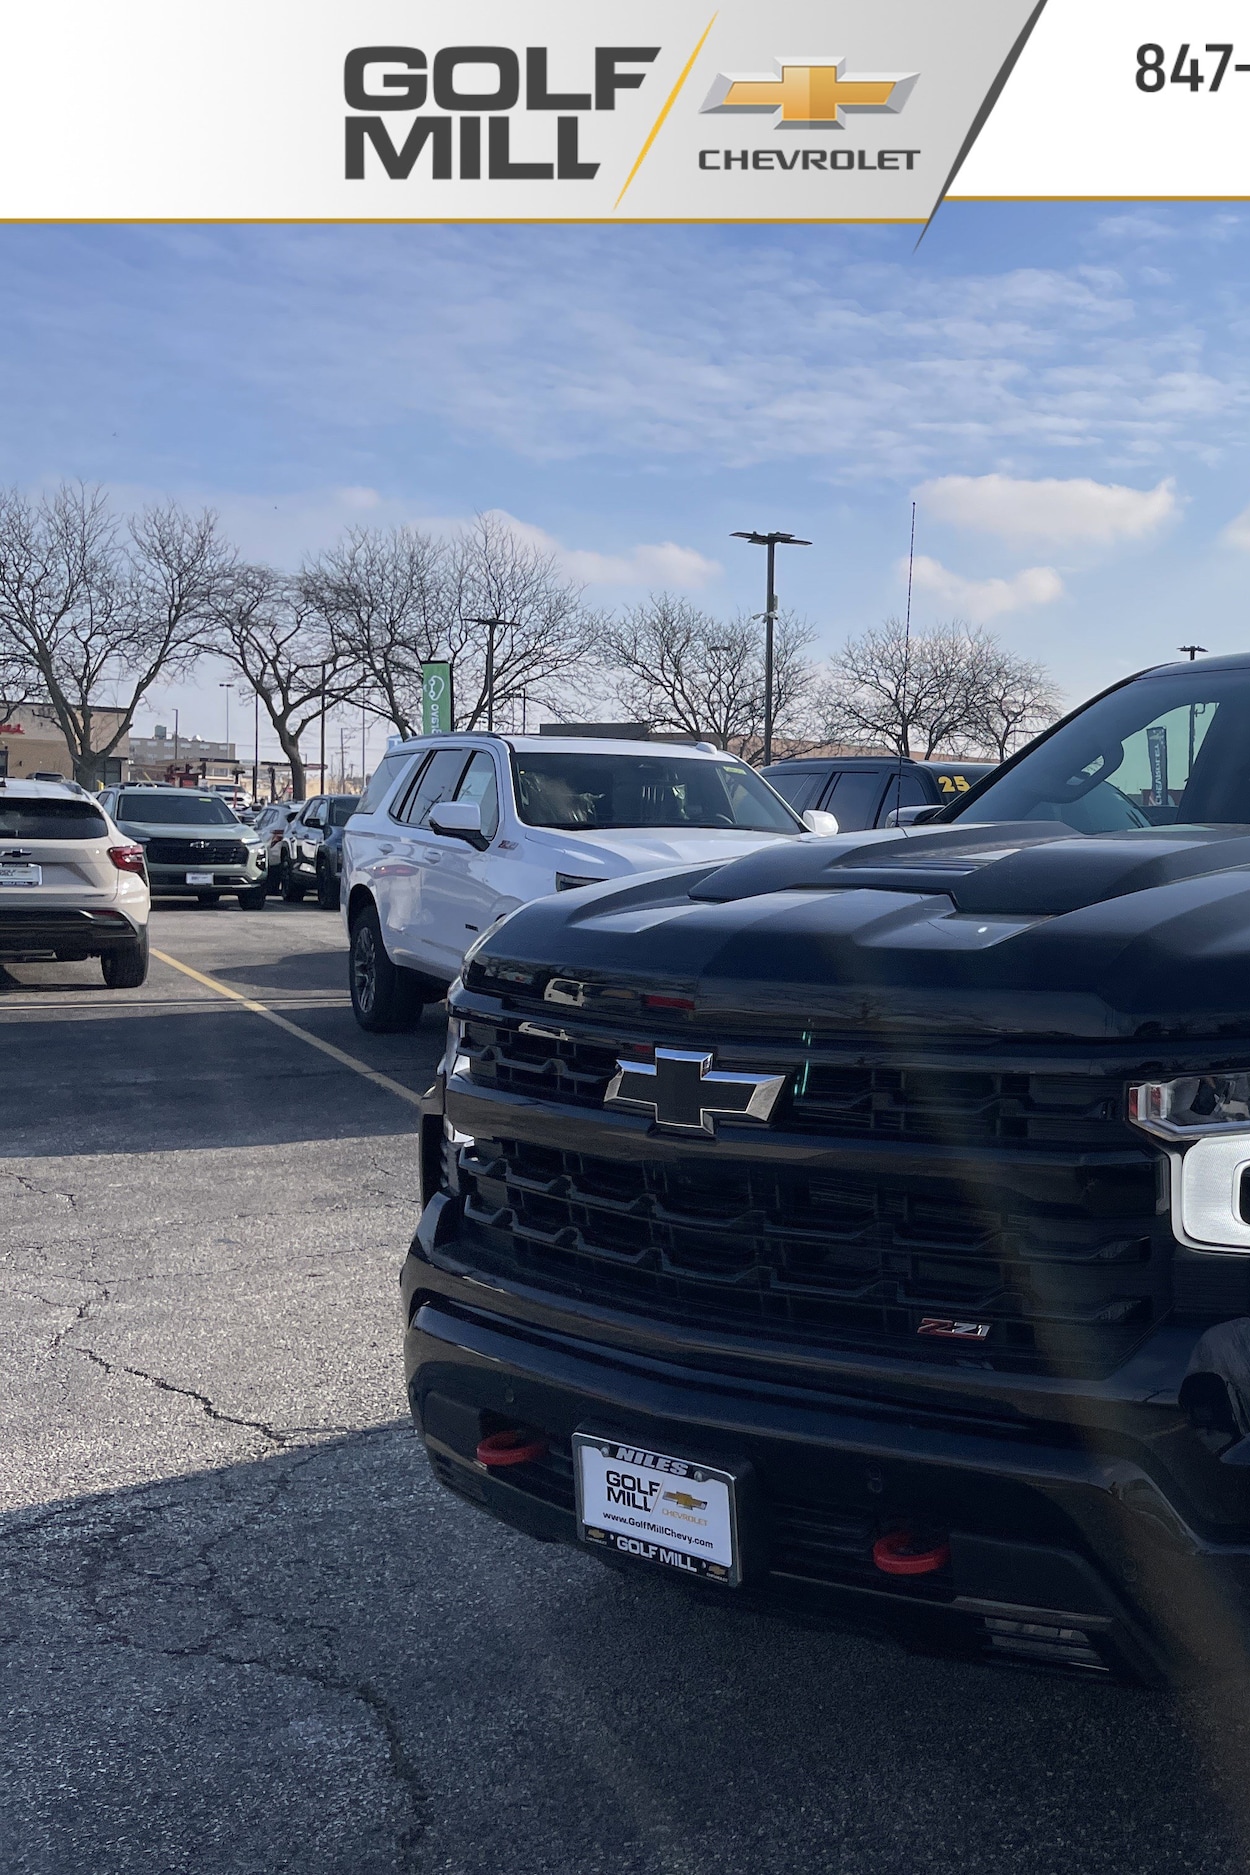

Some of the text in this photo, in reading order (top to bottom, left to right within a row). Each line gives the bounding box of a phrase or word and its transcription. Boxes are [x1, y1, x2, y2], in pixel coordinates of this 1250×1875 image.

[937, 775, 971, 793] 25
[615, 1446, 690, 1477] NILES
[606, 1470, 661, 1497] GOLF
[606, 1486, 652, 1513] MILL
[602, 1511, 715, 1550] www.GolfMillChevy.com
[661, 1507, 709, 1527] CHEVROLET
[616, 1535, 698, 1573] GOLF MILL
